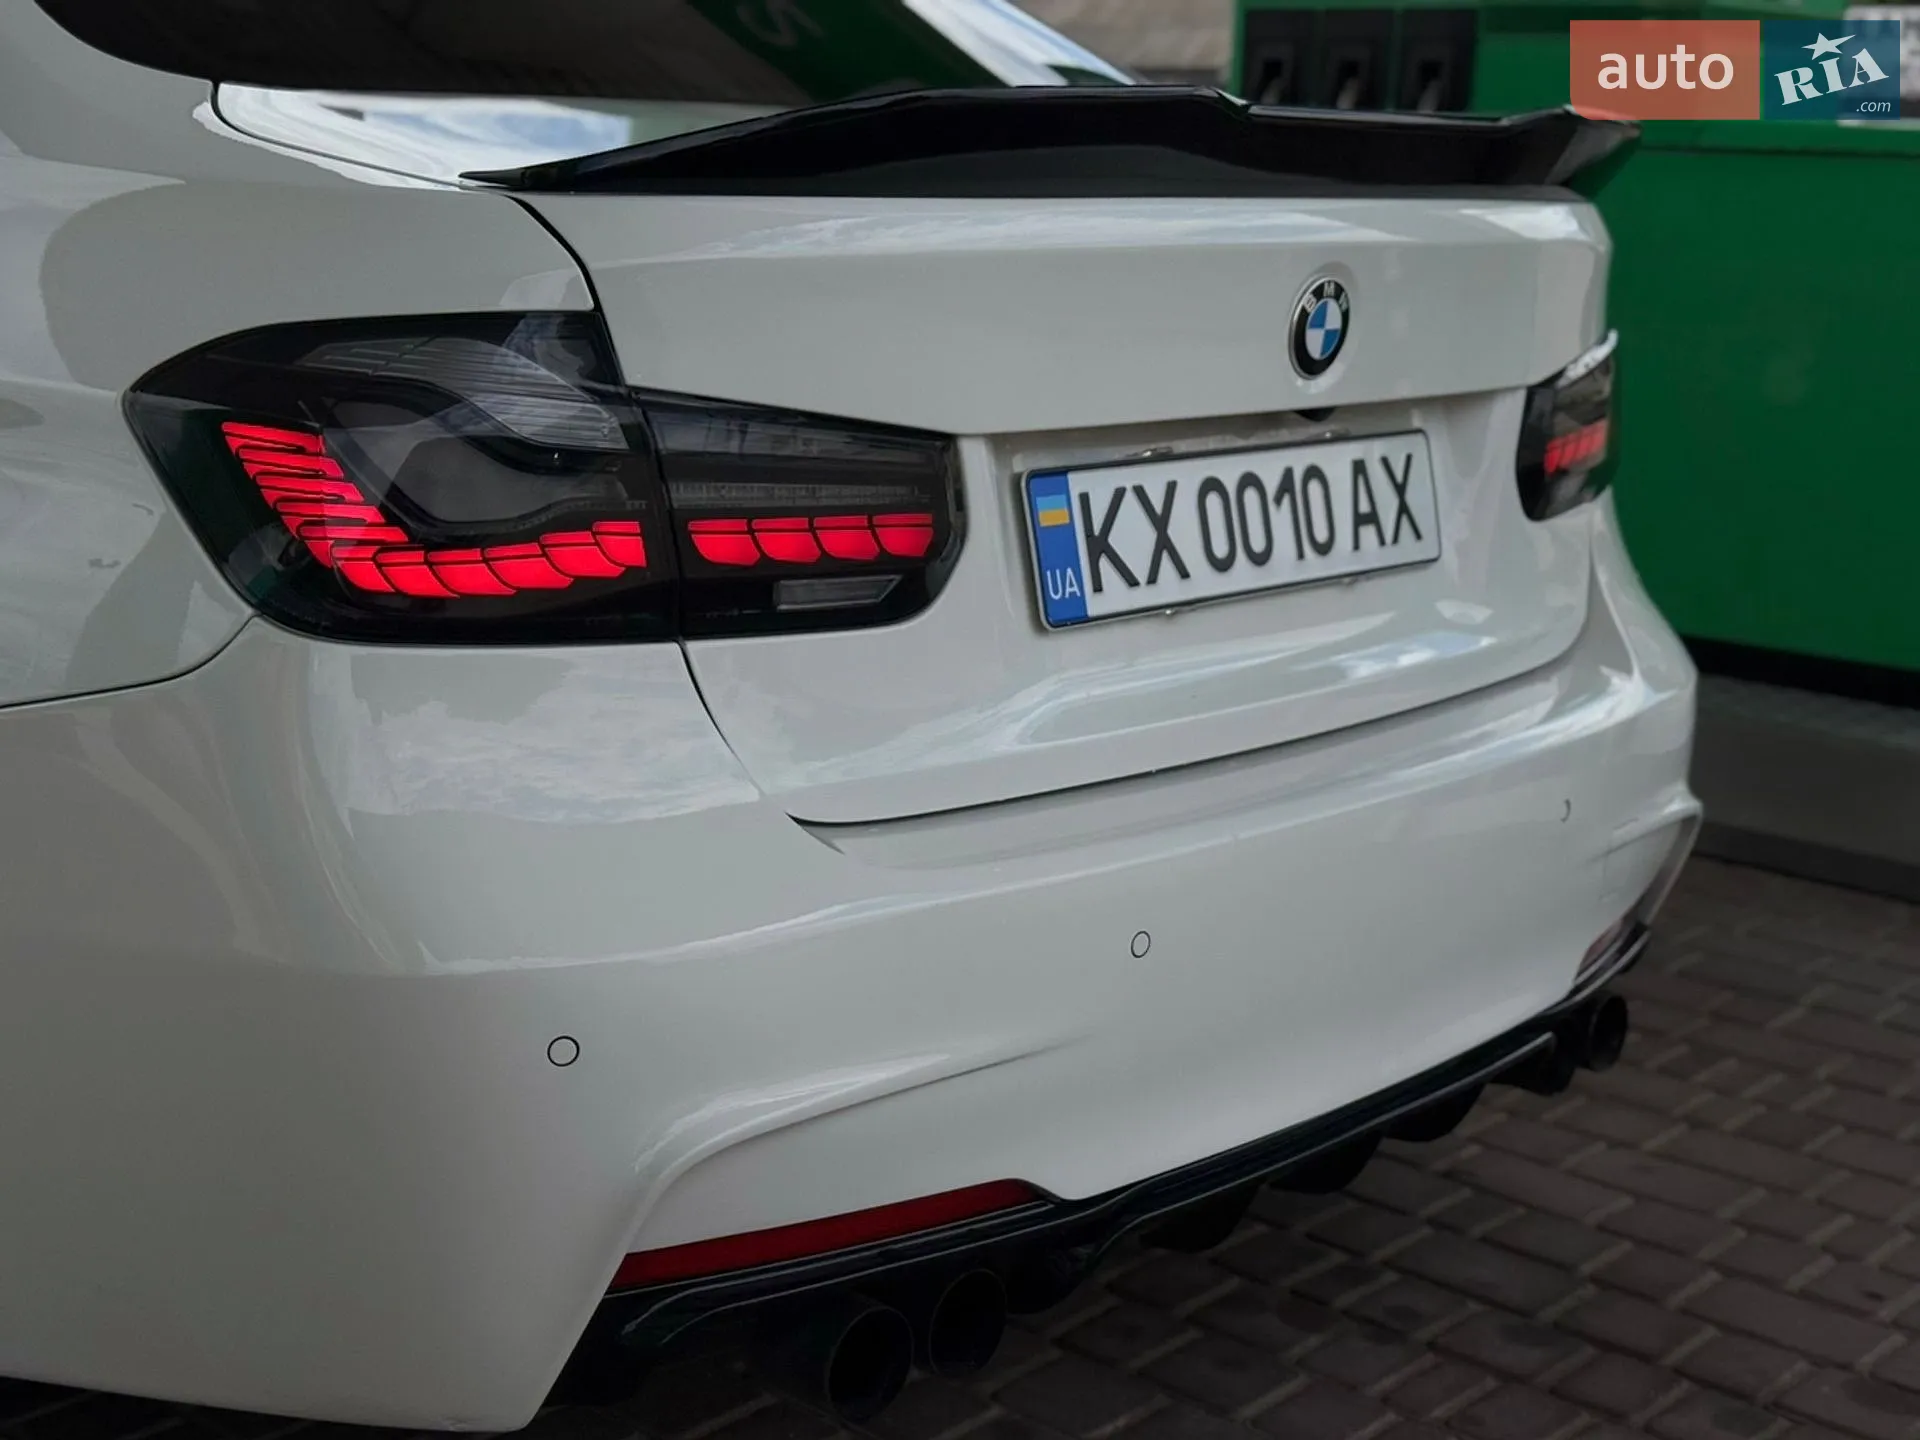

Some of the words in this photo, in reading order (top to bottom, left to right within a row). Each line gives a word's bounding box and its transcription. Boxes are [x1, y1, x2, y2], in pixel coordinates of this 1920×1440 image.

[1302, 280, 1349, 312] BMW
[1079, 480, 1190, 593] KX
[1199, 464, 1336, 572] 0010
[1352, 453, 1423, 551] AX
[1047, 567, 1081, 600] UA
